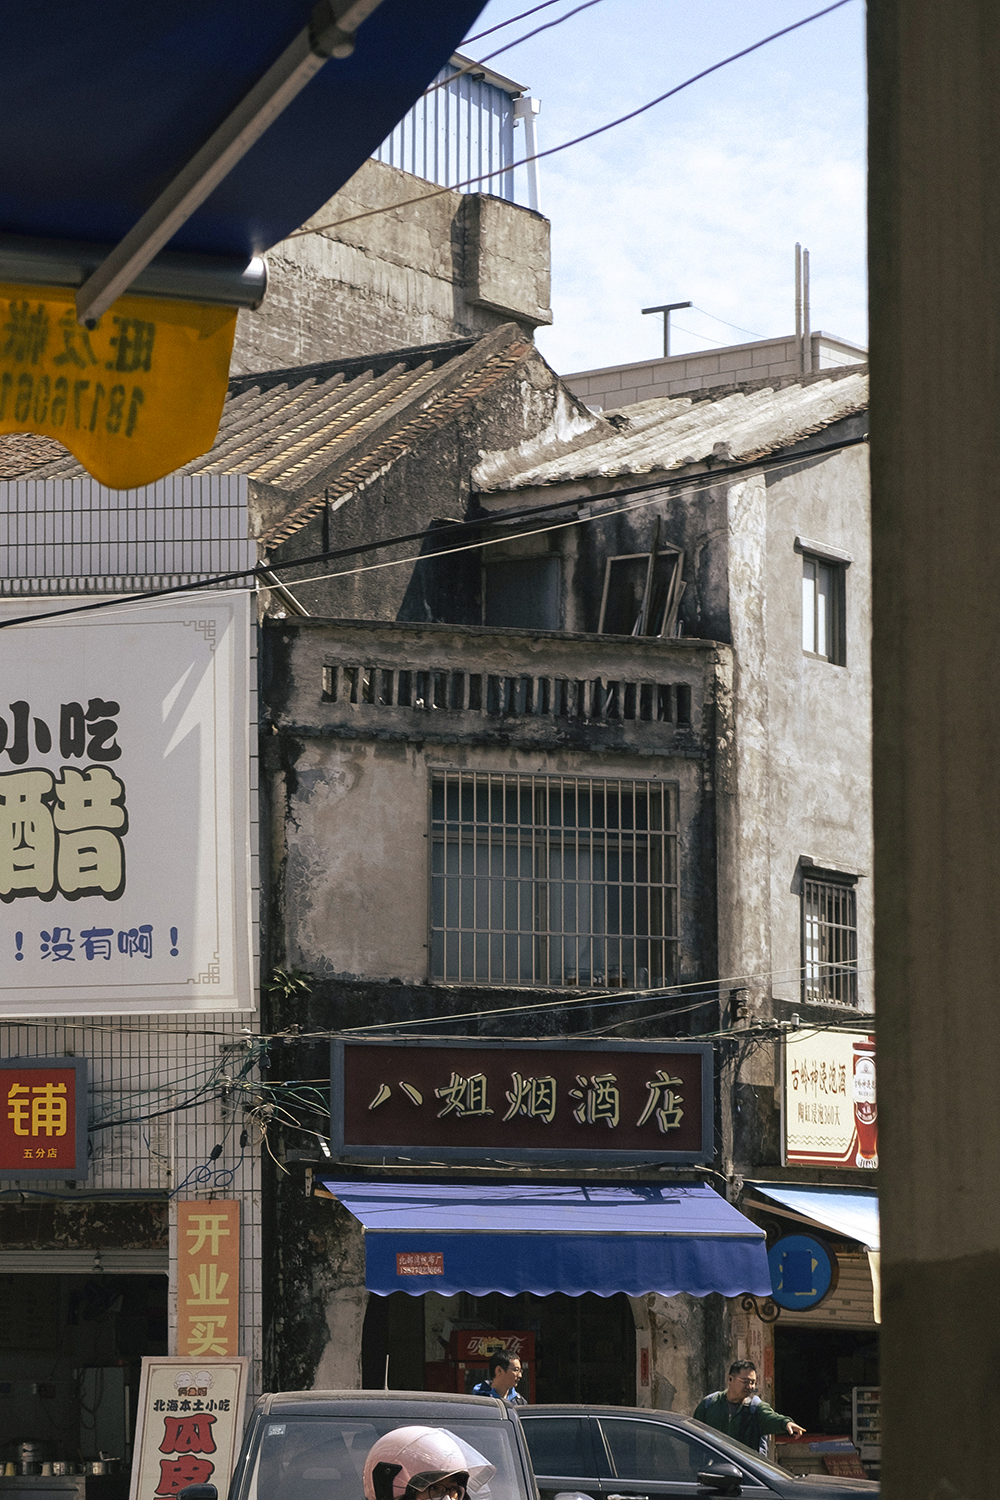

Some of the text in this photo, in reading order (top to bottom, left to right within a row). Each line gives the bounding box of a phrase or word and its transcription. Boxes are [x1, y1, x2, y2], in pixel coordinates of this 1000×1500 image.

[368, 1070, 684, 1133] 八姐烟酒店
[23, 1148, 58, 1159] 五分店
[186, 1214, 231, 1356] 开业买
[153, 1399, 231, 1412] 北海本土小吃
